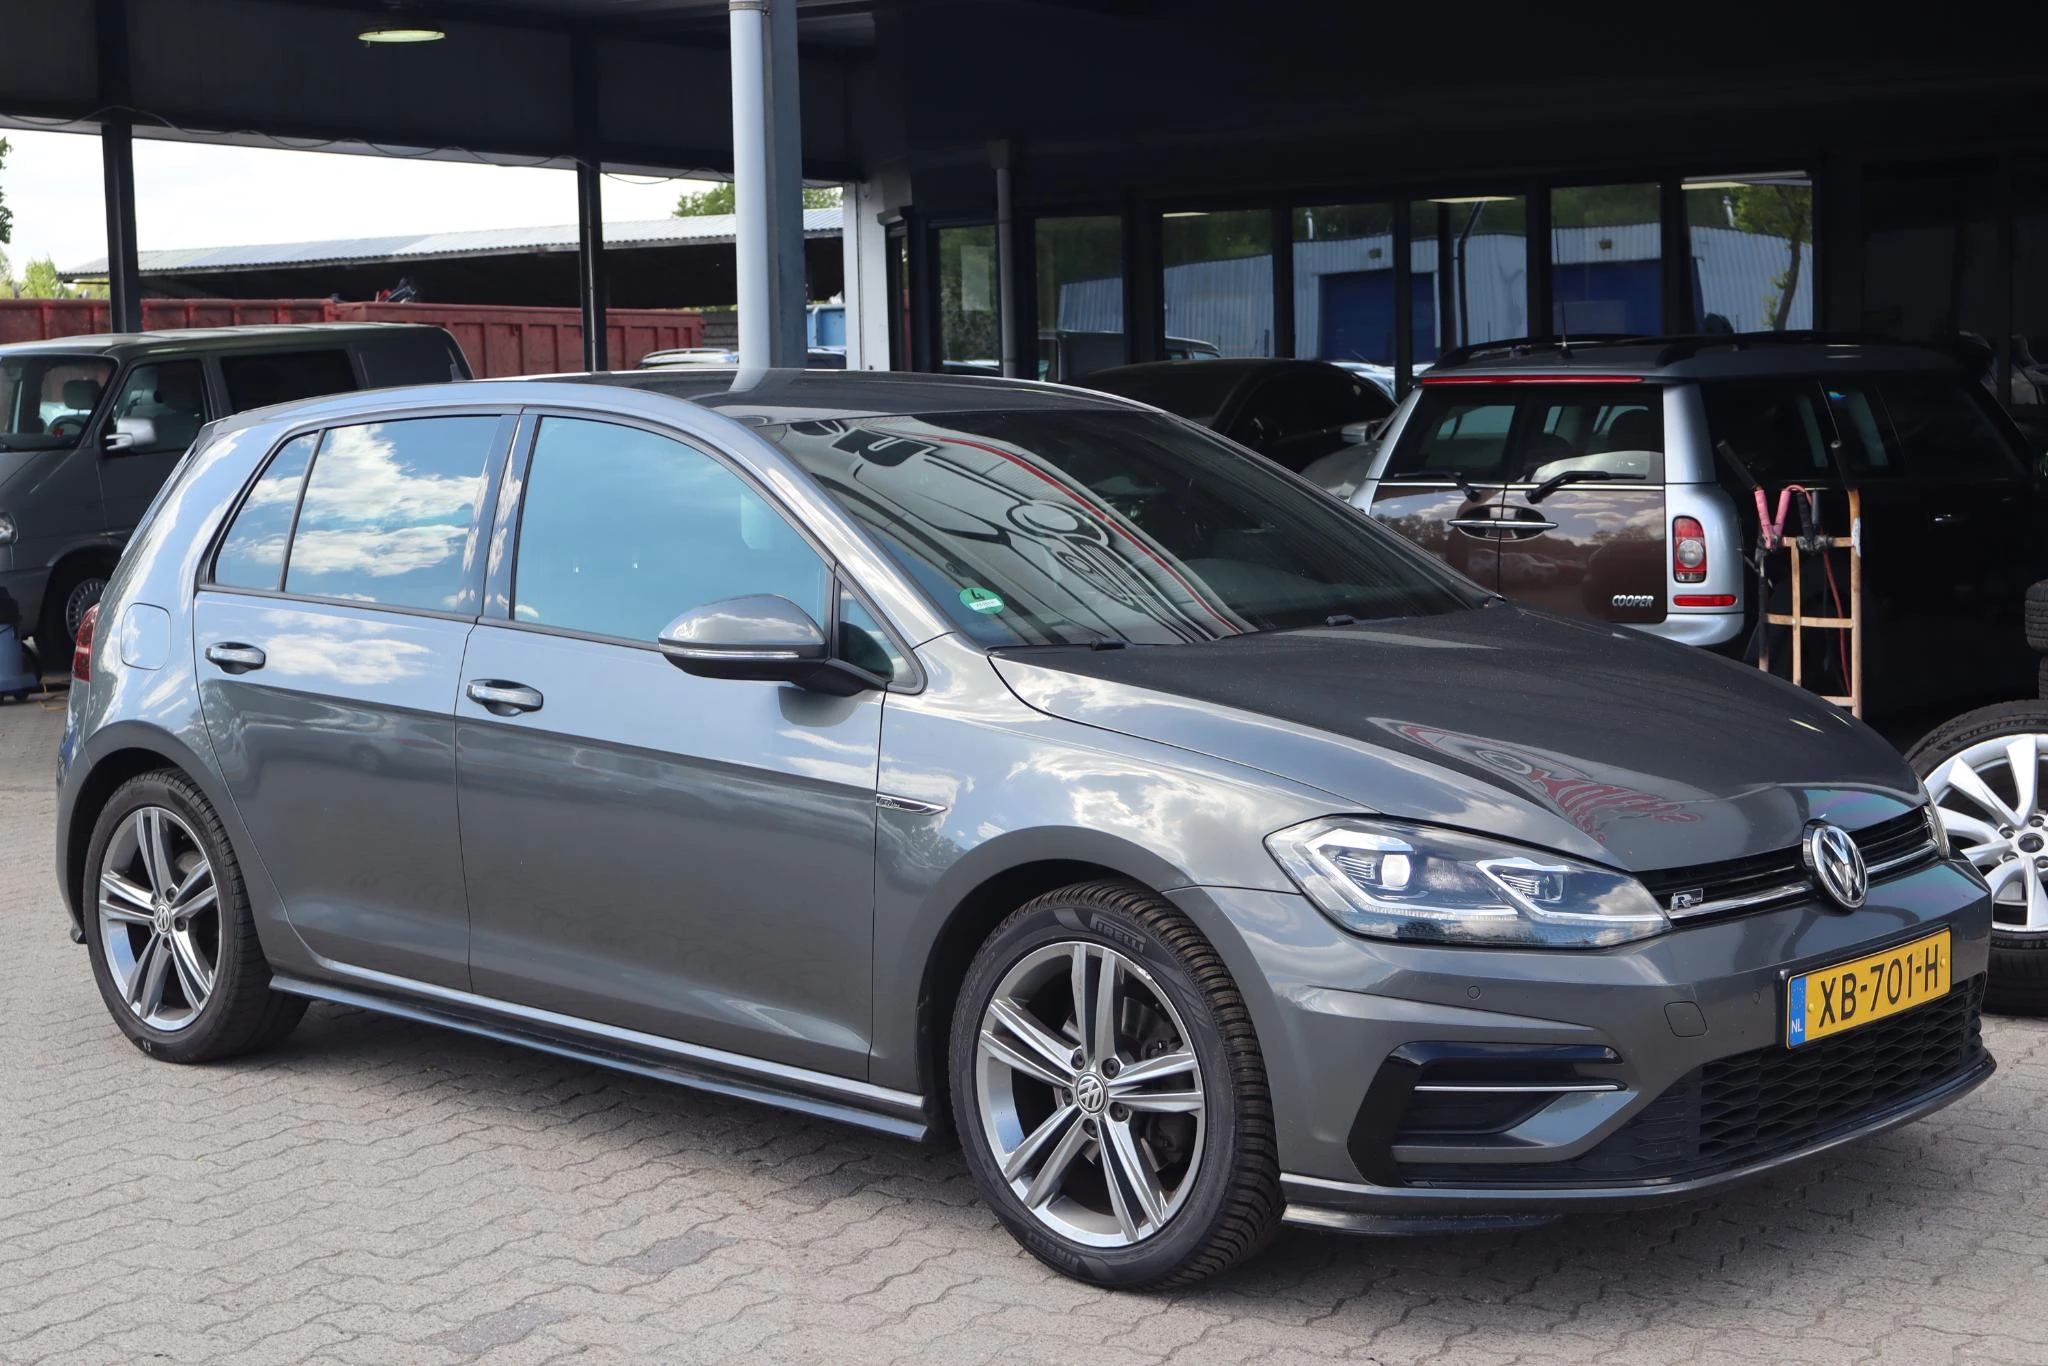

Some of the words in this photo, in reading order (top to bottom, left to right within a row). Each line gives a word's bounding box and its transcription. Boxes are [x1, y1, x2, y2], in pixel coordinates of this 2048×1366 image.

[1612, 594, 1655, 607] COOPER
[1090, 912, 1148, 953] PIRELLI
[1819, 944, 1938, 1028] XB-701-H
[1791, 1018, 1803, 1033] NL
